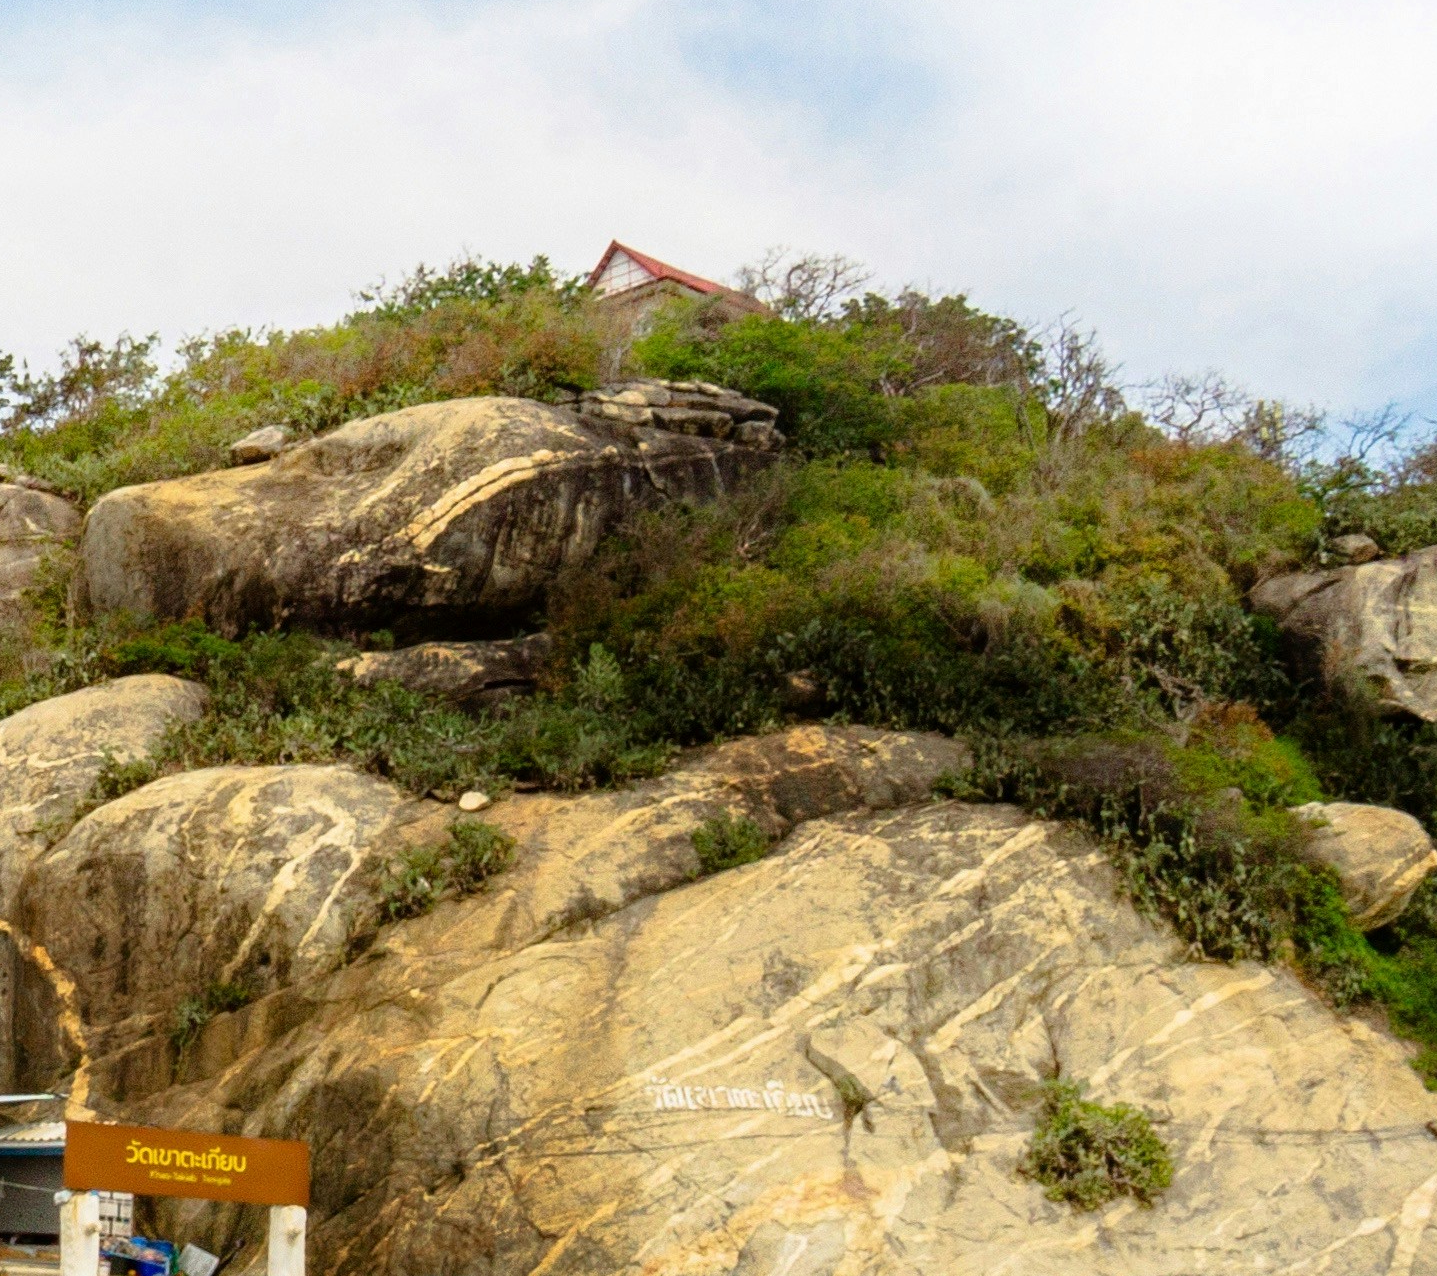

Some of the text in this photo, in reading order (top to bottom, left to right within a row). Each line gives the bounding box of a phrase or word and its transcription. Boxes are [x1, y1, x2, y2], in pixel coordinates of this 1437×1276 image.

[126, 1140, 247, 1172] วัดเขาตะเกียบ
